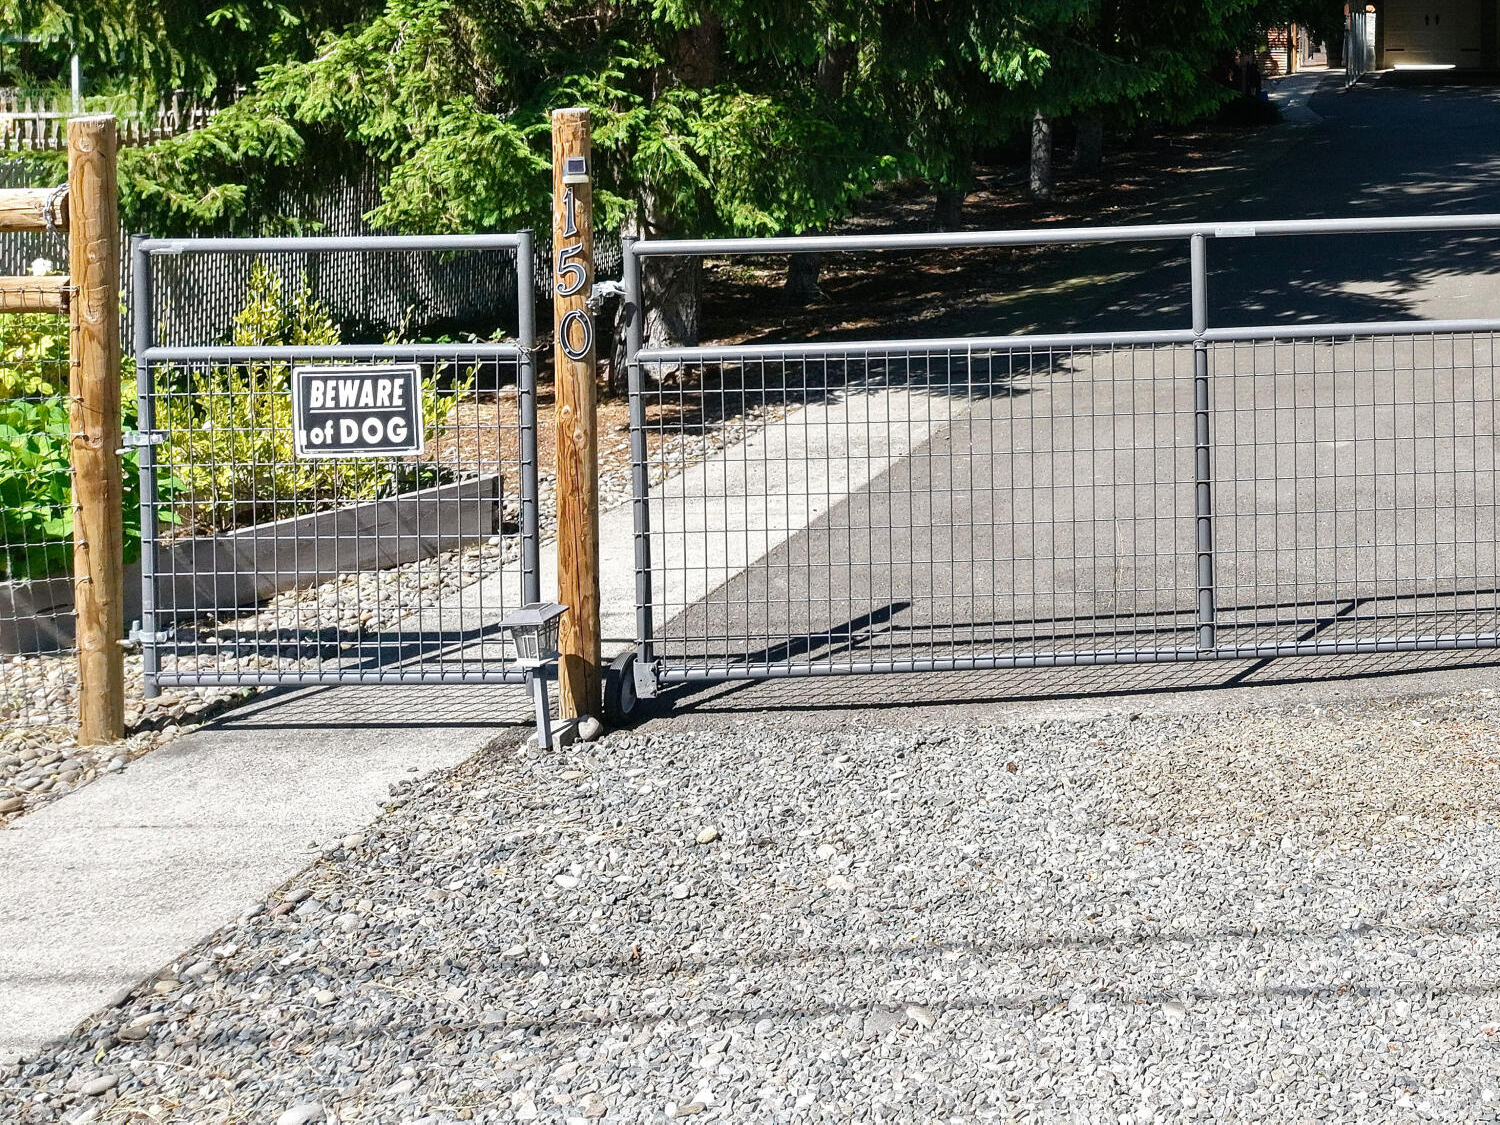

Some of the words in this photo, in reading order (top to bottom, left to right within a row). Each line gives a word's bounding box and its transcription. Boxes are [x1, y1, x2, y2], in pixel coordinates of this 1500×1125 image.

[556, 187, 593, 360] 150
[310, 378, 405, 408] BEWARE
[310, 420, 334, 445] of
[339, 416, 408, 444] DOG
